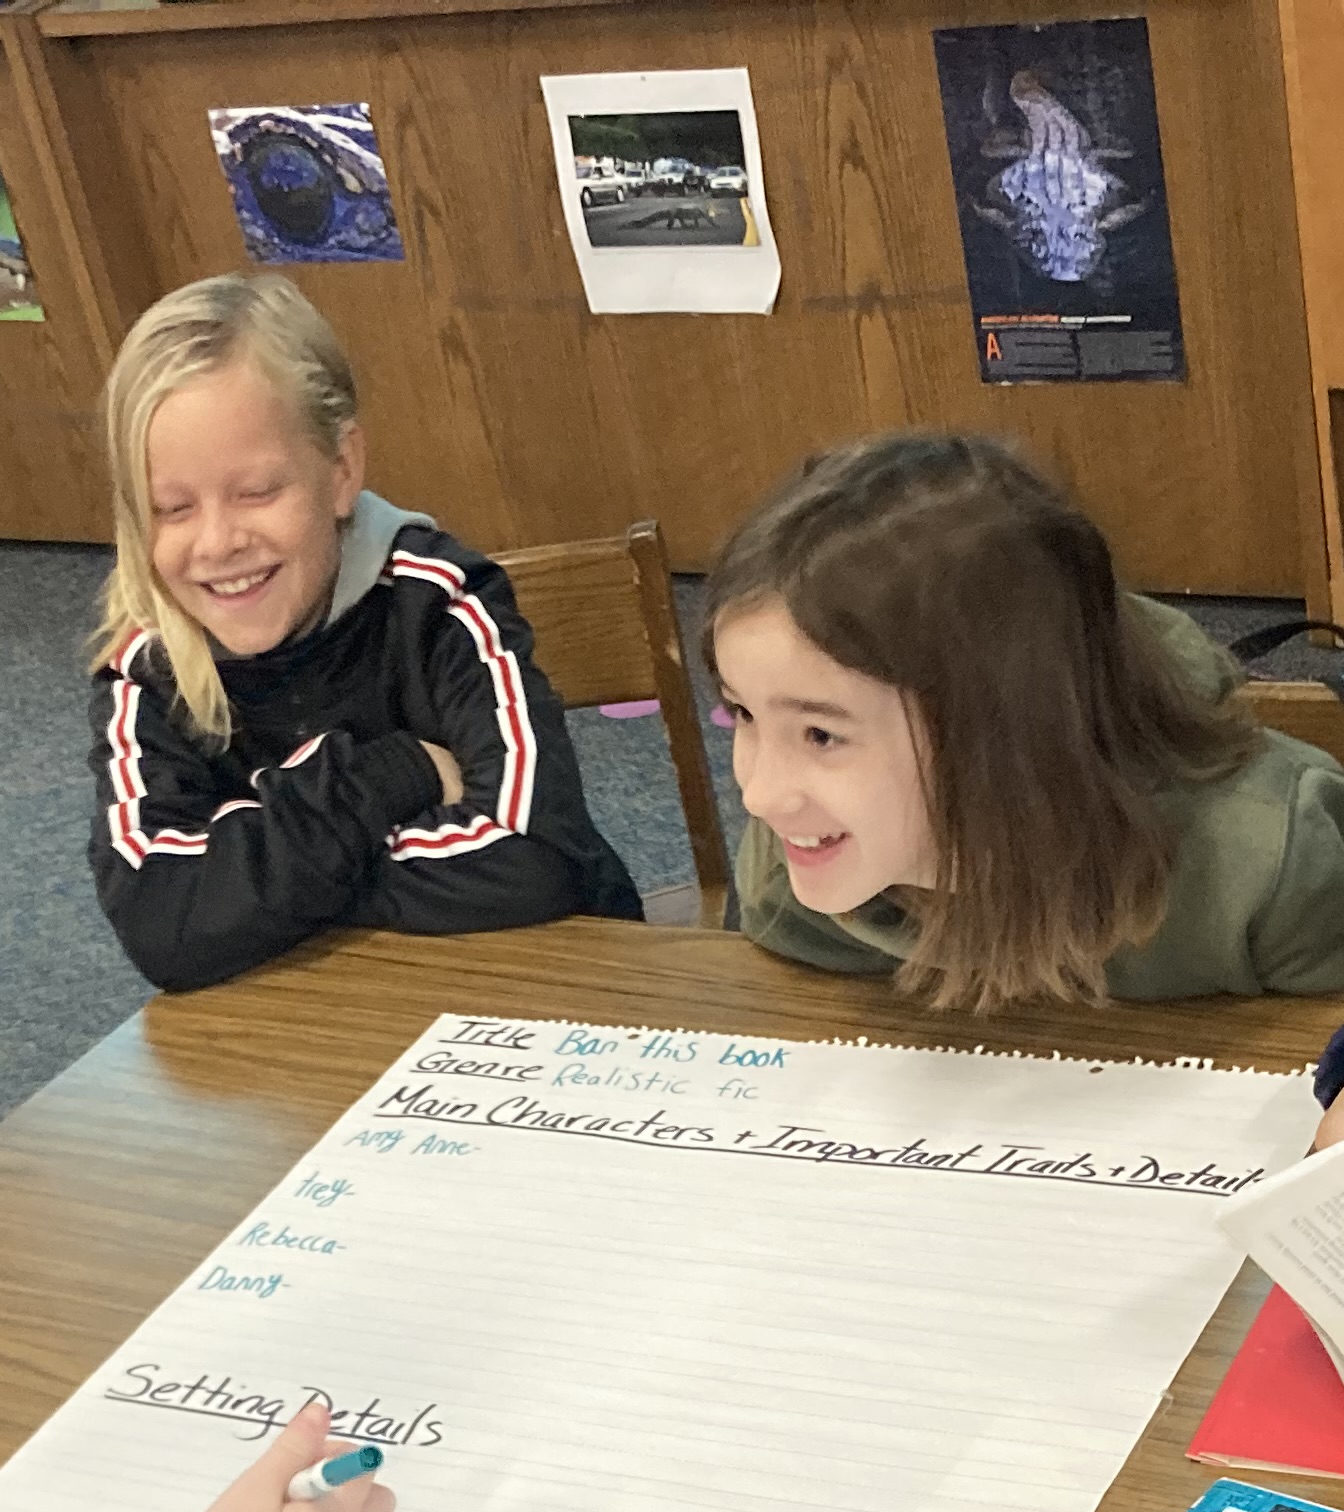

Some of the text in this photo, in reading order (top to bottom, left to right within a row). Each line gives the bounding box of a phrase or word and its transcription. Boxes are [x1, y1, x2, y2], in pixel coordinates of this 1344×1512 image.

[986, 332, 1002, 361] A
[458, 1021, 538, 1048] Title
[554, 1029, 619, 1056] Ban
[720, 1043, 790, 1068] book
[415, 1051, 760, 1100] Genre Realistic fic
[378, 1084, 477, 1119] Main
[486, 1096, 715, 1144] Characters
[756, 1125, 984, 1168] Important
[983, 1144, 1097, 1178] Traits
[1126, 1155, 1265, 1192] Detail
[108, 1363, 443, 1446] Setting Details
